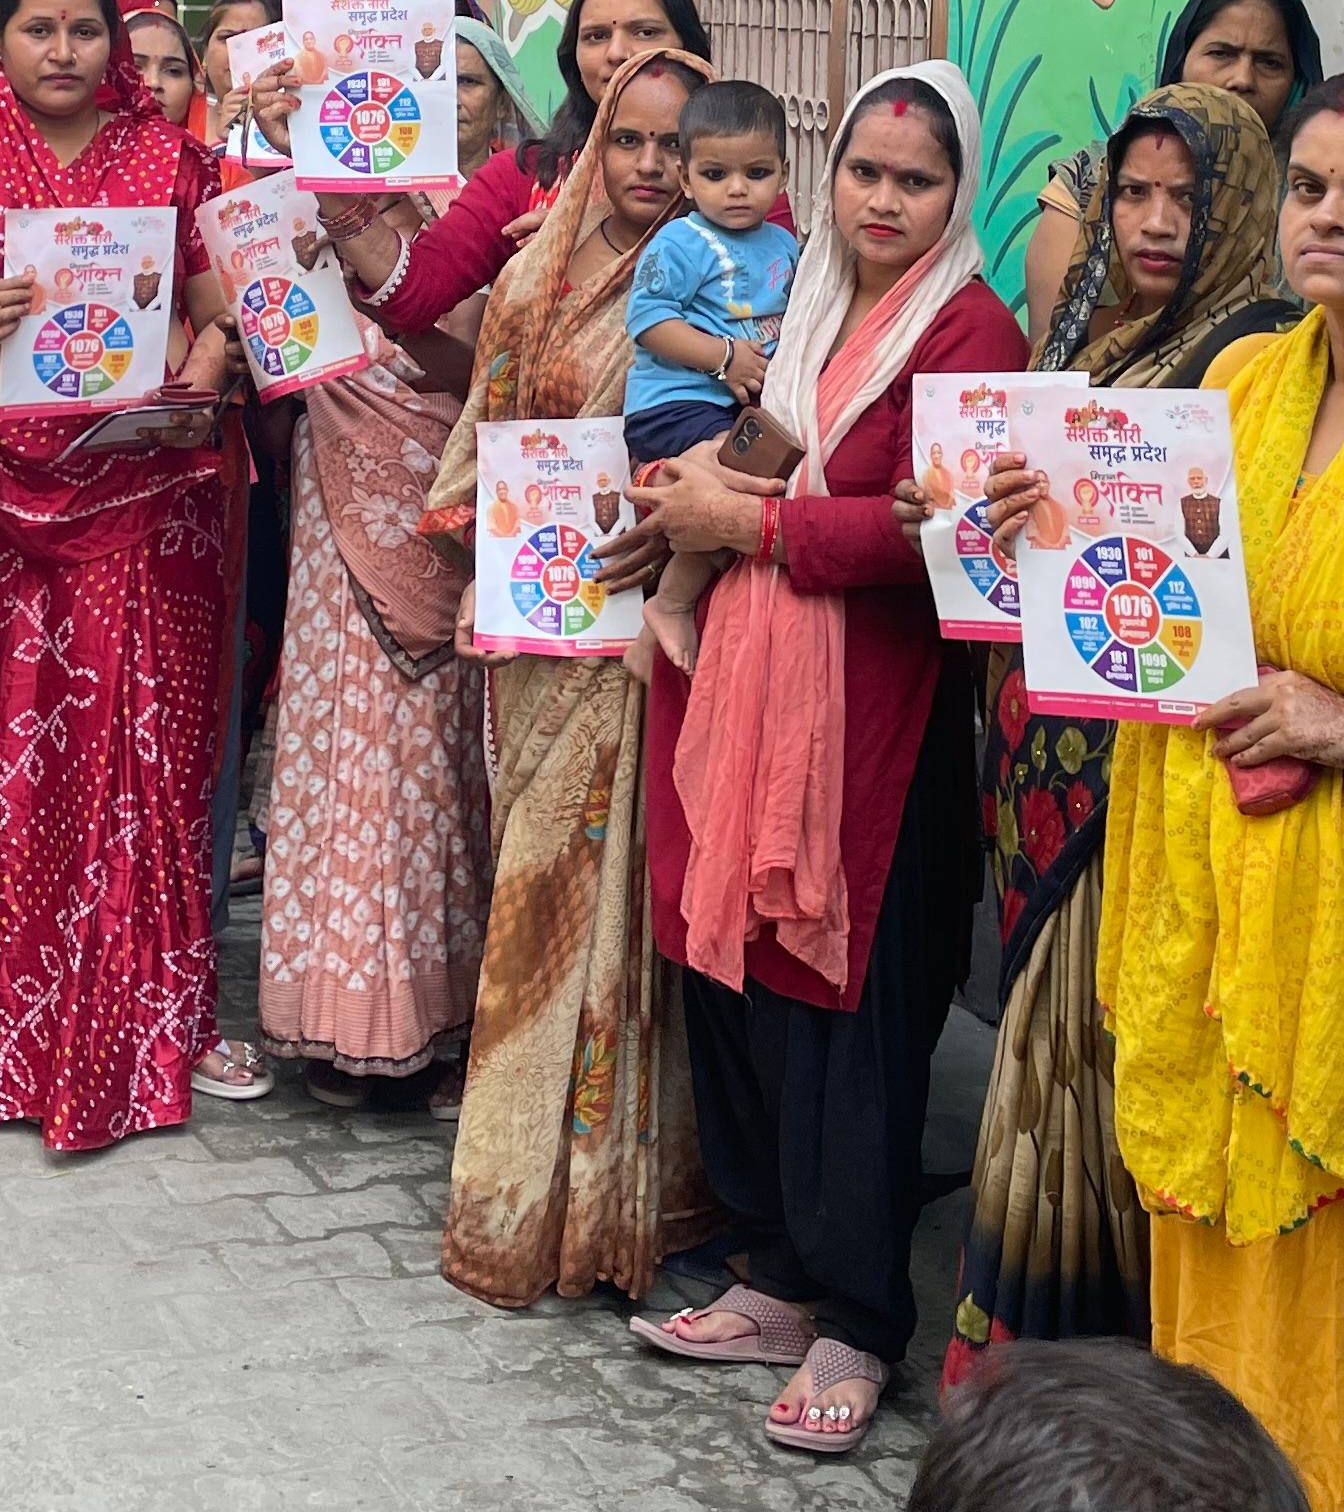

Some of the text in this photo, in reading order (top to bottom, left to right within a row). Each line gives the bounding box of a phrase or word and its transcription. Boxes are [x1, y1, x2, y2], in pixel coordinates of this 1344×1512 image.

[355, 109, 385, 125] 1076
[70, 339, 99, 353] 1076
[1113, 423, 1142, 443] नारी
[1088, 441, 1167, 467] समृद्ध प्रदेश
[1095, 546, 1123, 560] 1930
[1168, 581, 1185, 594] 112
[1111, 594, 1152, 617] 1076
